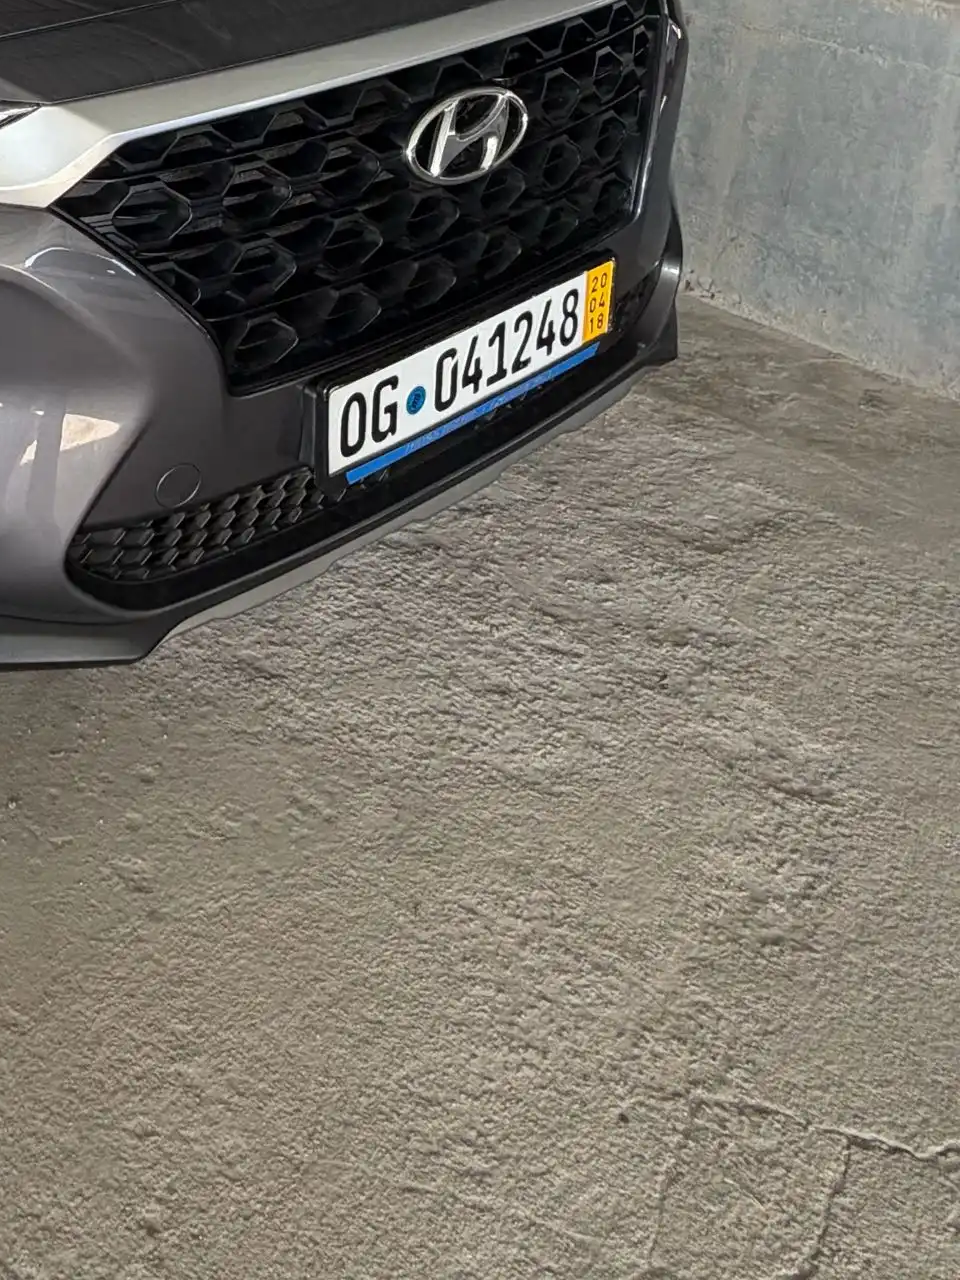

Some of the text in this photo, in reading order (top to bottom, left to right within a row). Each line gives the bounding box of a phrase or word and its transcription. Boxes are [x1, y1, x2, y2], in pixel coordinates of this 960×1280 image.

[591, 272, 608, 293] 20
[590, 291, 605, 313] 04
[590, 312, 604, 334] 18
[340, 288, 580, 458] OG 041248
